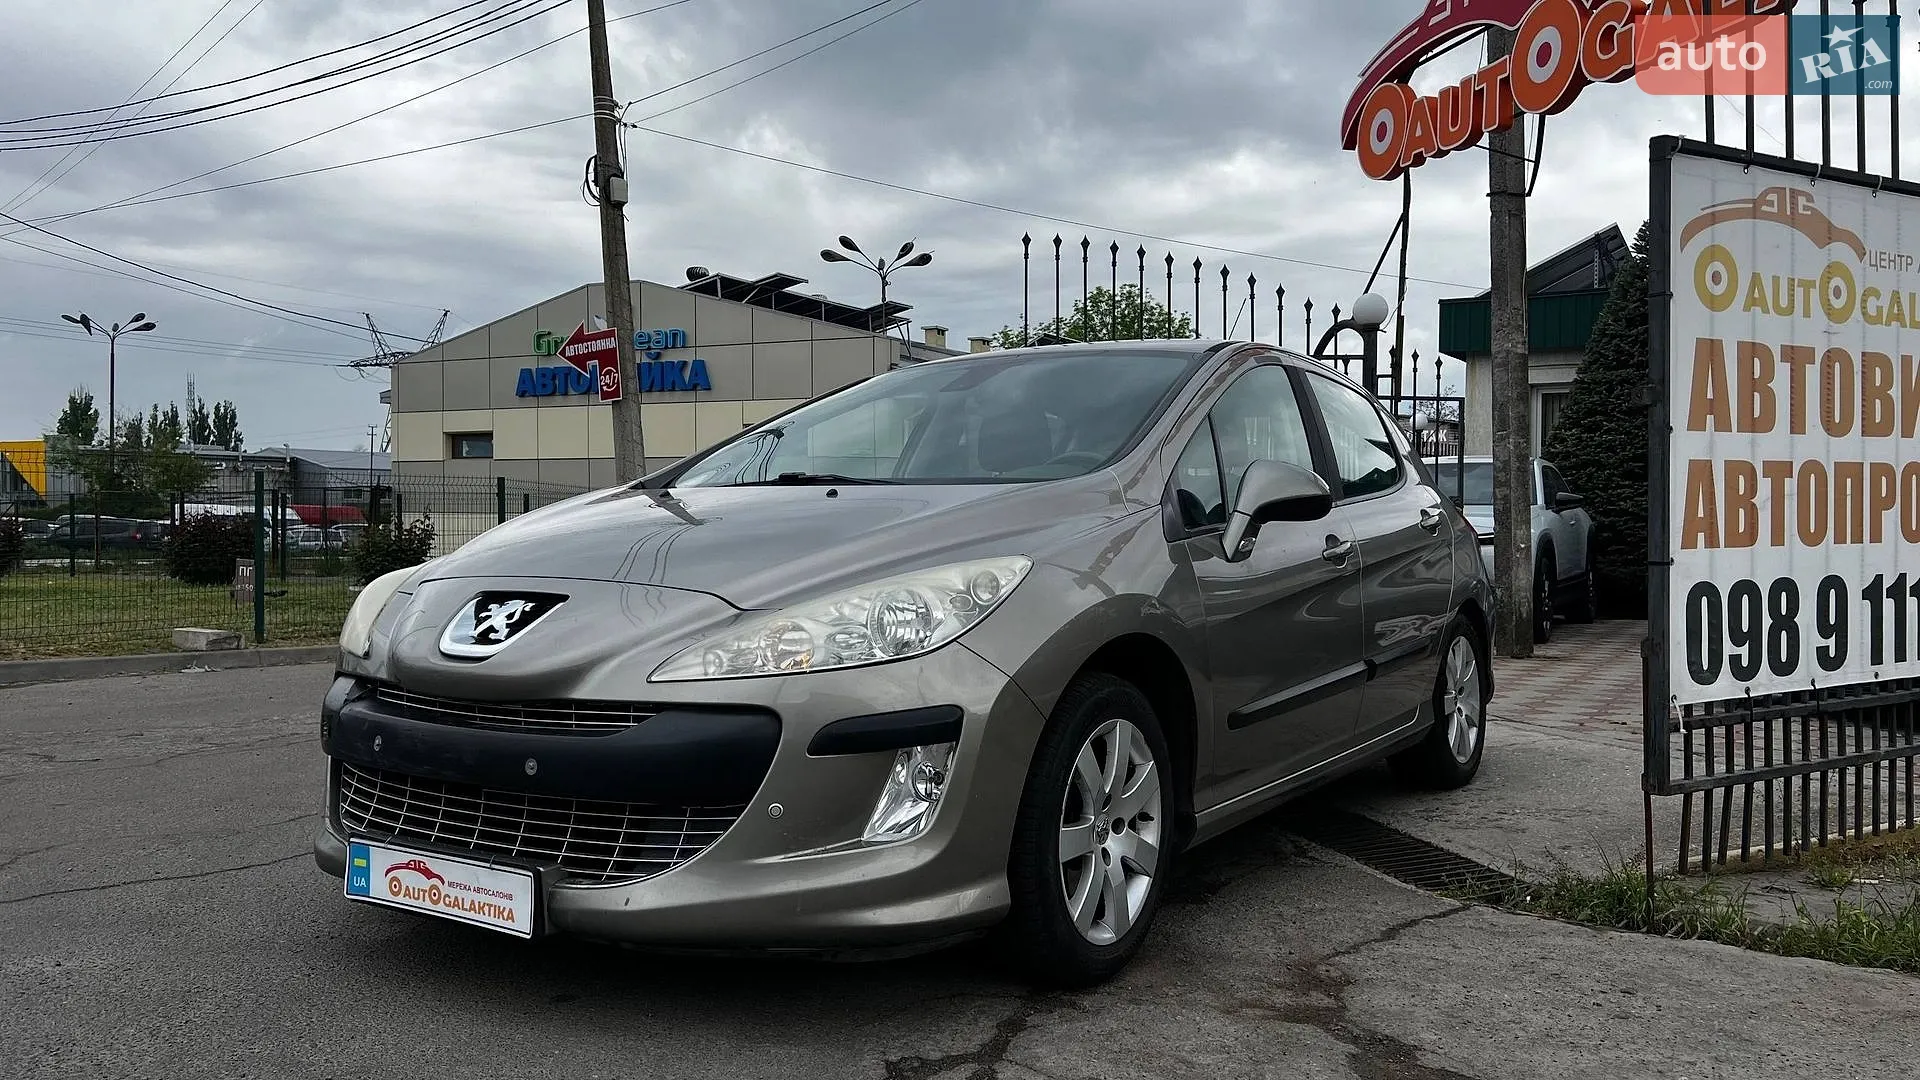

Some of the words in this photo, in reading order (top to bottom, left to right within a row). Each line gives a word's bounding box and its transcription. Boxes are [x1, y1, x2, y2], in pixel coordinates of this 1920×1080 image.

[1869, 249, 1913, 272] ЦЕНТР
[565, 337, 616, 357] АВТОСТОЯНКА
[634, 328, 686, 350] ean
[516, 350, 711, 397] АВТОЙКА
[600, 372, 618, 386] 24/7
[1680, 459, 1920, 550] АВТОПРО
[239, 566, 253, 577] ПГ
[1685, 576, 1800, 686] 098
[1815, 574, 1849, 672] 9
[353, 876, 367, 888] UA
[447, 880, 472, 893] МЕРЕЖА
[473, 886, 514, 901] АВТОСАЛОНІВ
